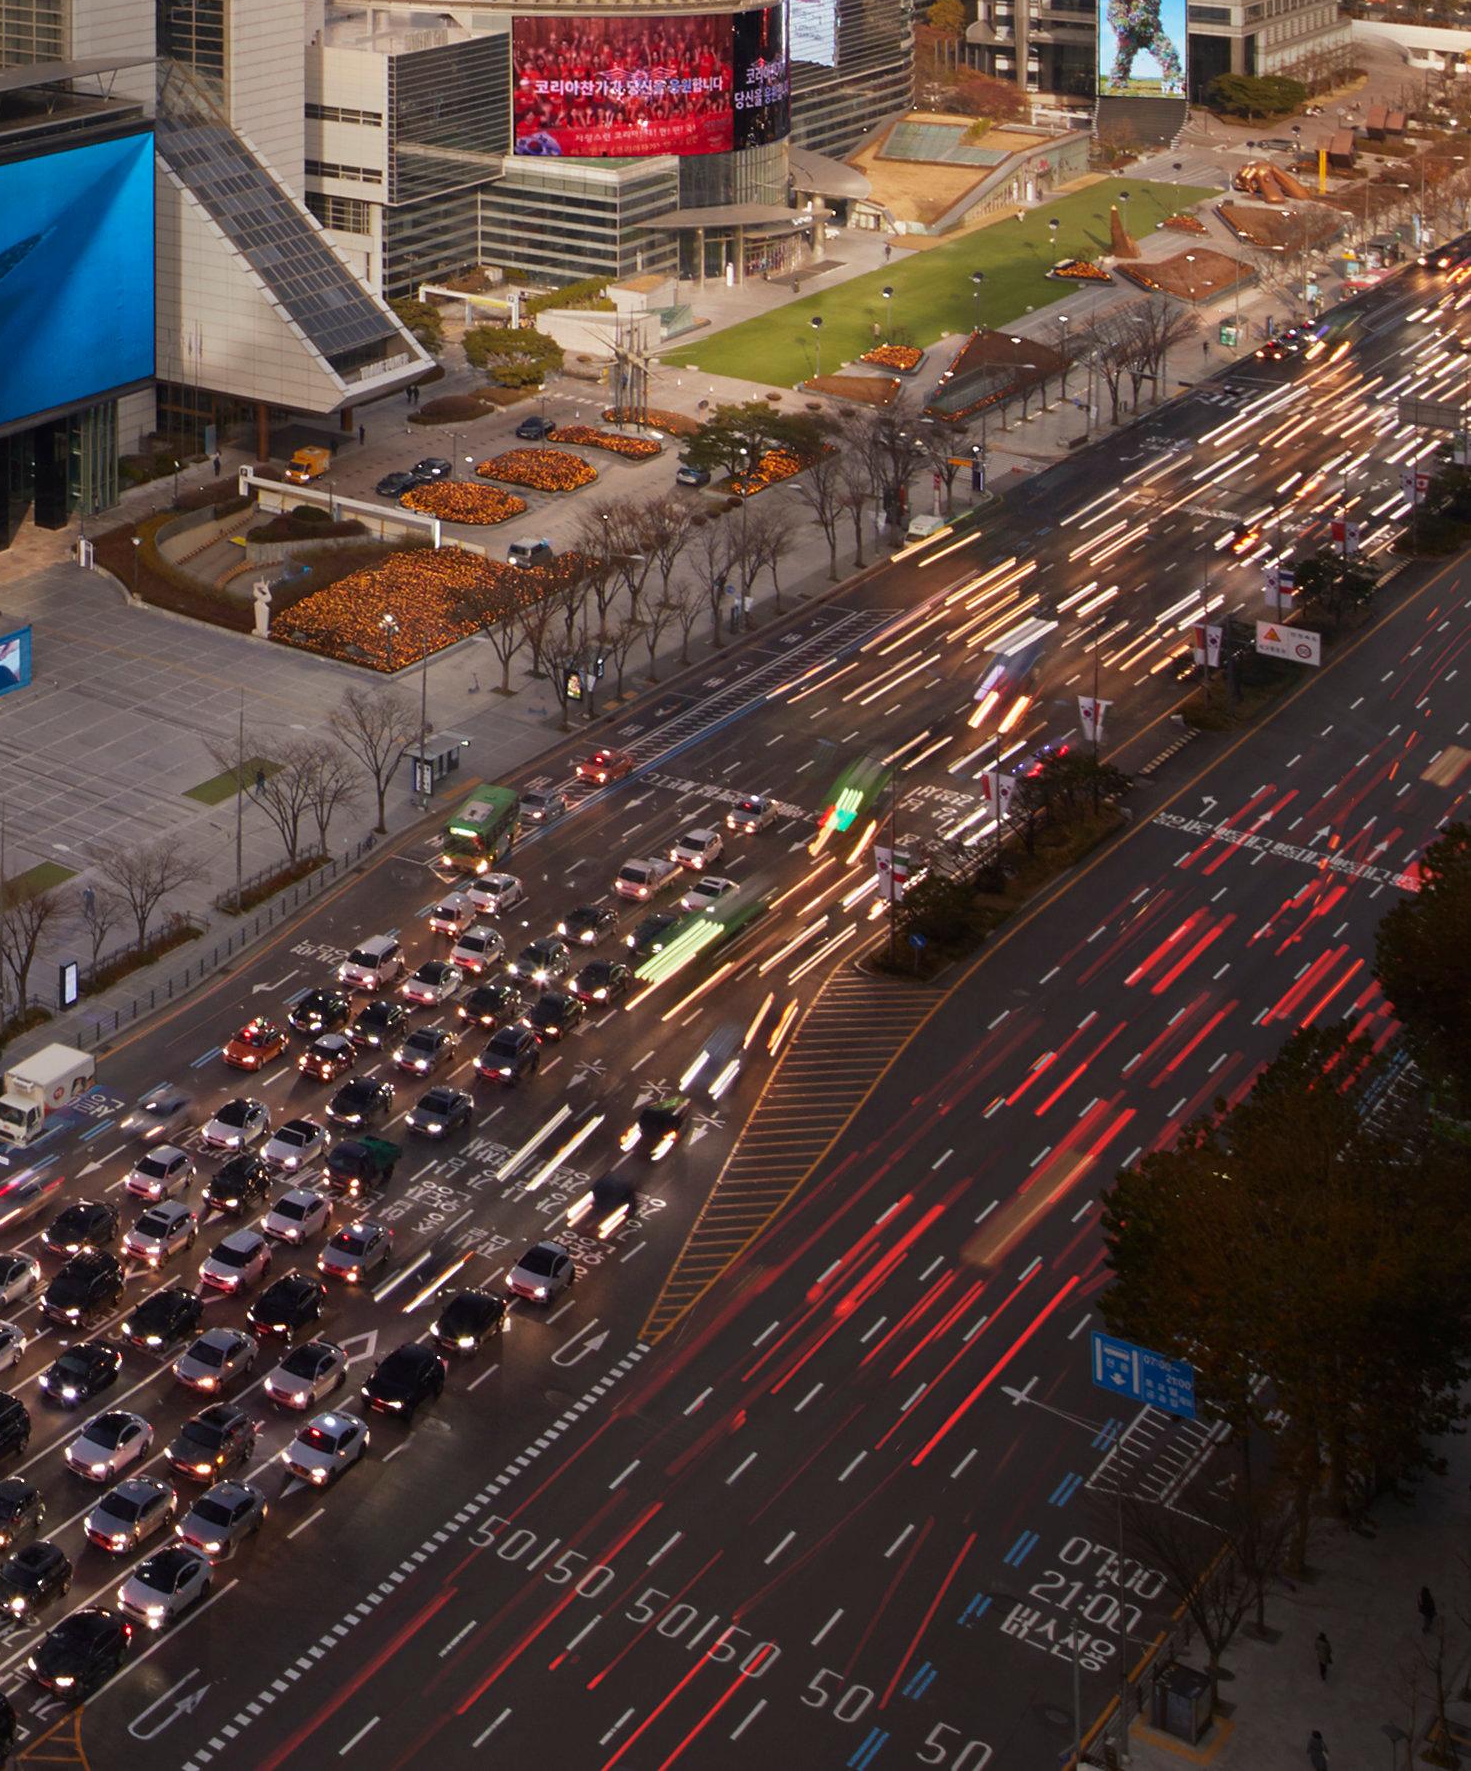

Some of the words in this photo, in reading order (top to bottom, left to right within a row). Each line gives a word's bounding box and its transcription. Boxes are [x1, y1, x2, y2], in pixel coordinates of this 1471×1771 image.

[669, 75, 724, 94] 응원합니다
[734, 89, 763, 110] 당신을
[1058, 1534, 1168, 1601] 07:00
[1028, 1569, 1143, 1636] 21:00
[468, 1514, 536, 1564] 50
[543, 1549, 616, 1599] 50
[624, 1586, 698, 1640] 50
[706, 1625, 781, 1680] 50
[799, 1667, 876, 1724] 50
[916, 1720, 993, 1771] 50
[999, 1601, 1118, 1674] 버스전용
